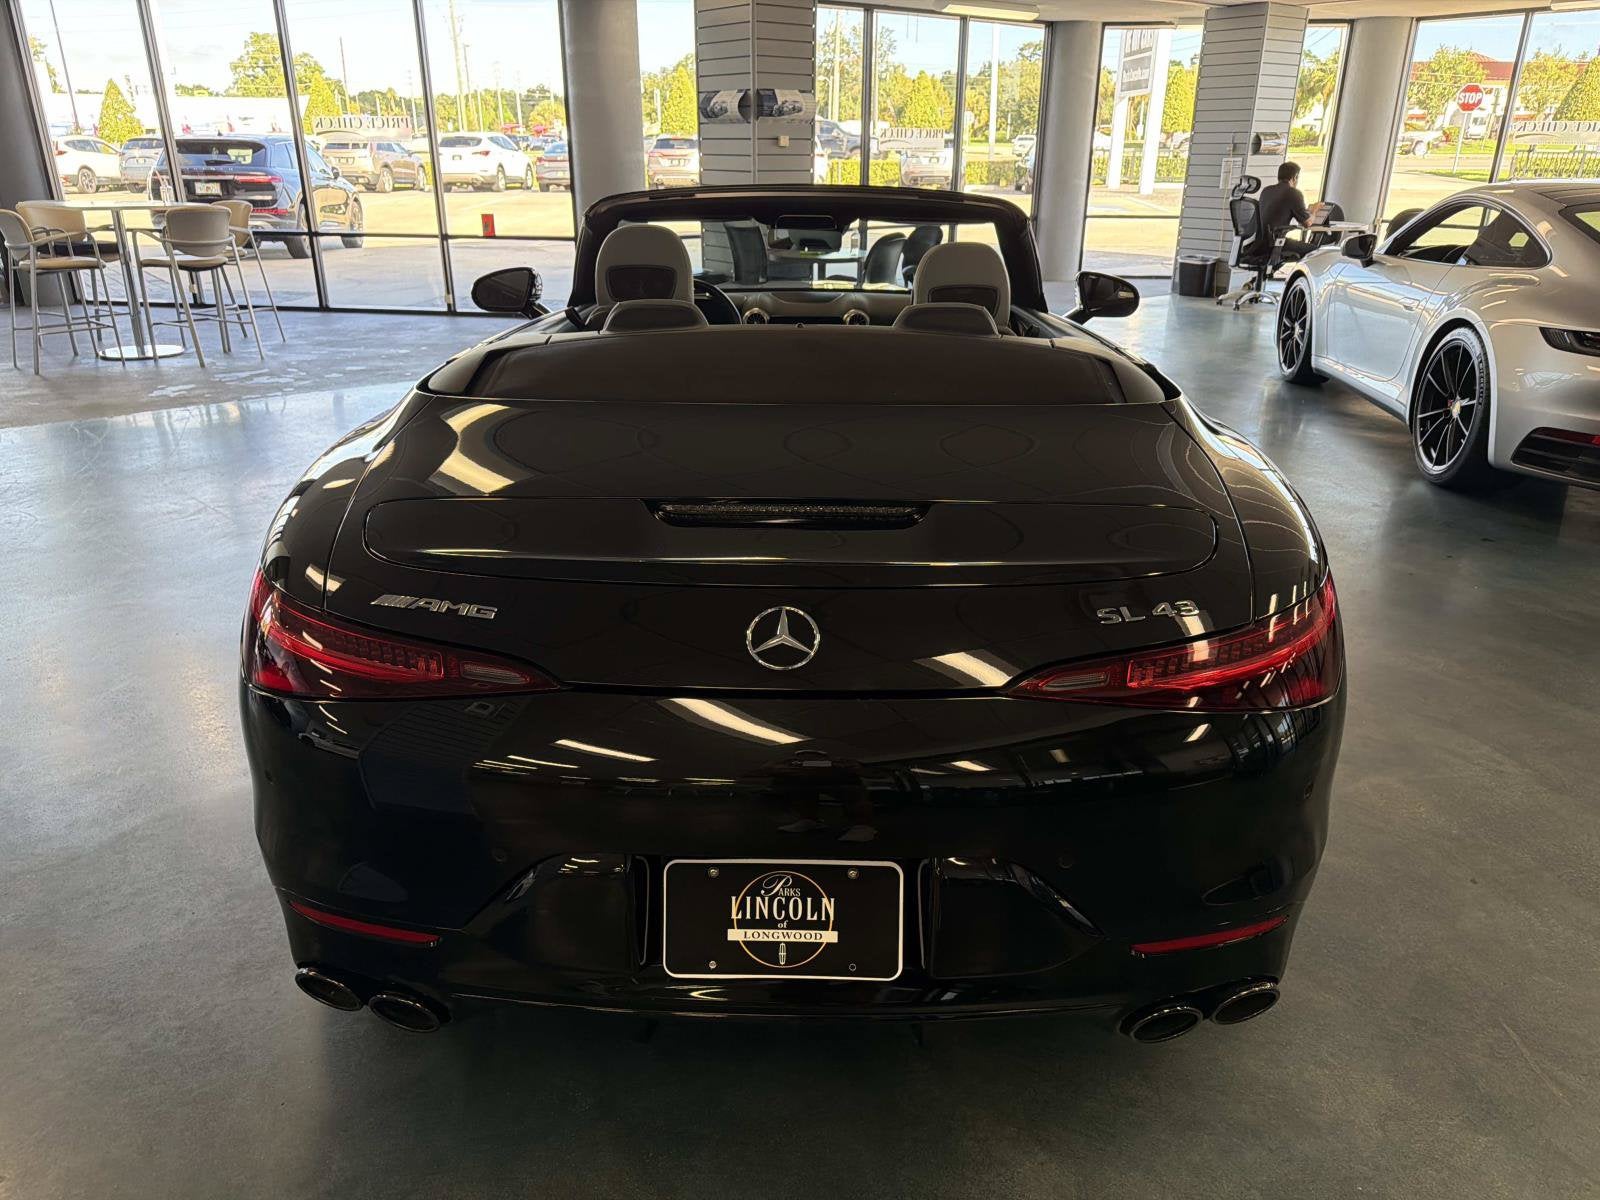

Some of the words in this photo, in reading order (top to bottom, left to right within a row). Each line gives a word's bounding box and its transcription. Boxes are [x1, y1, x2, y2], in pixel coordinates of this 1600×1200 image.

[1458, 92, 1482, 104] STOP
[408, 597, 498, 619] AMG
[1096, 606, 1146, 624] SL
[1151, 600, 1200, 617] 43
[760, 874, 801, 897] PARKS
[730, 896, 836, 921] LINCOLN
[777, 920, 789, 929] of
[743, 930, 824, 942] LONGWOOD
